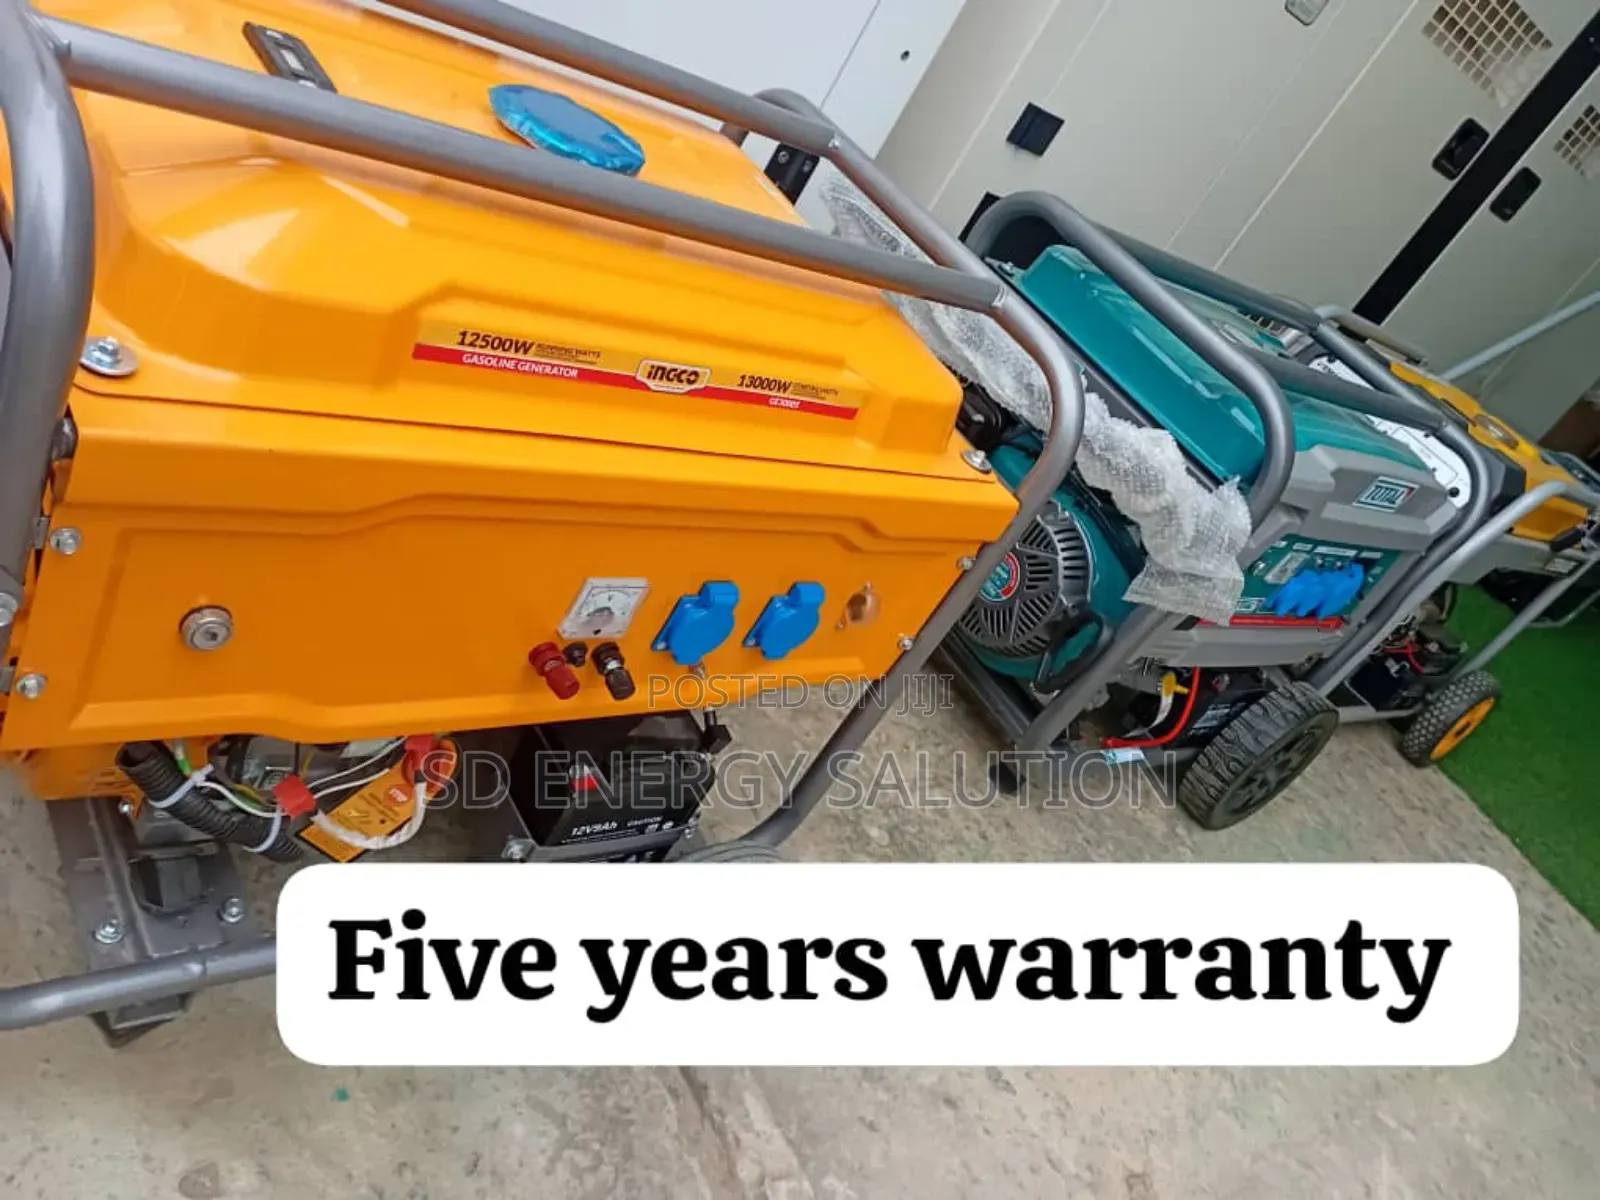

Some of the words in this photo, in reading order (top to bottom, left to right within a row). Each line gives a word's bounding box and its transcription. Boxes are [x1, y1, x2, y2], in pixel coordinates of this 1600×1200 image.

[456, 330, 534, 356] 12500W
[462, 352, 516, 371] GASOLINE
[517, 361, 578, 378] GENERATOR
[738, 374, 793, 394] 13000W
